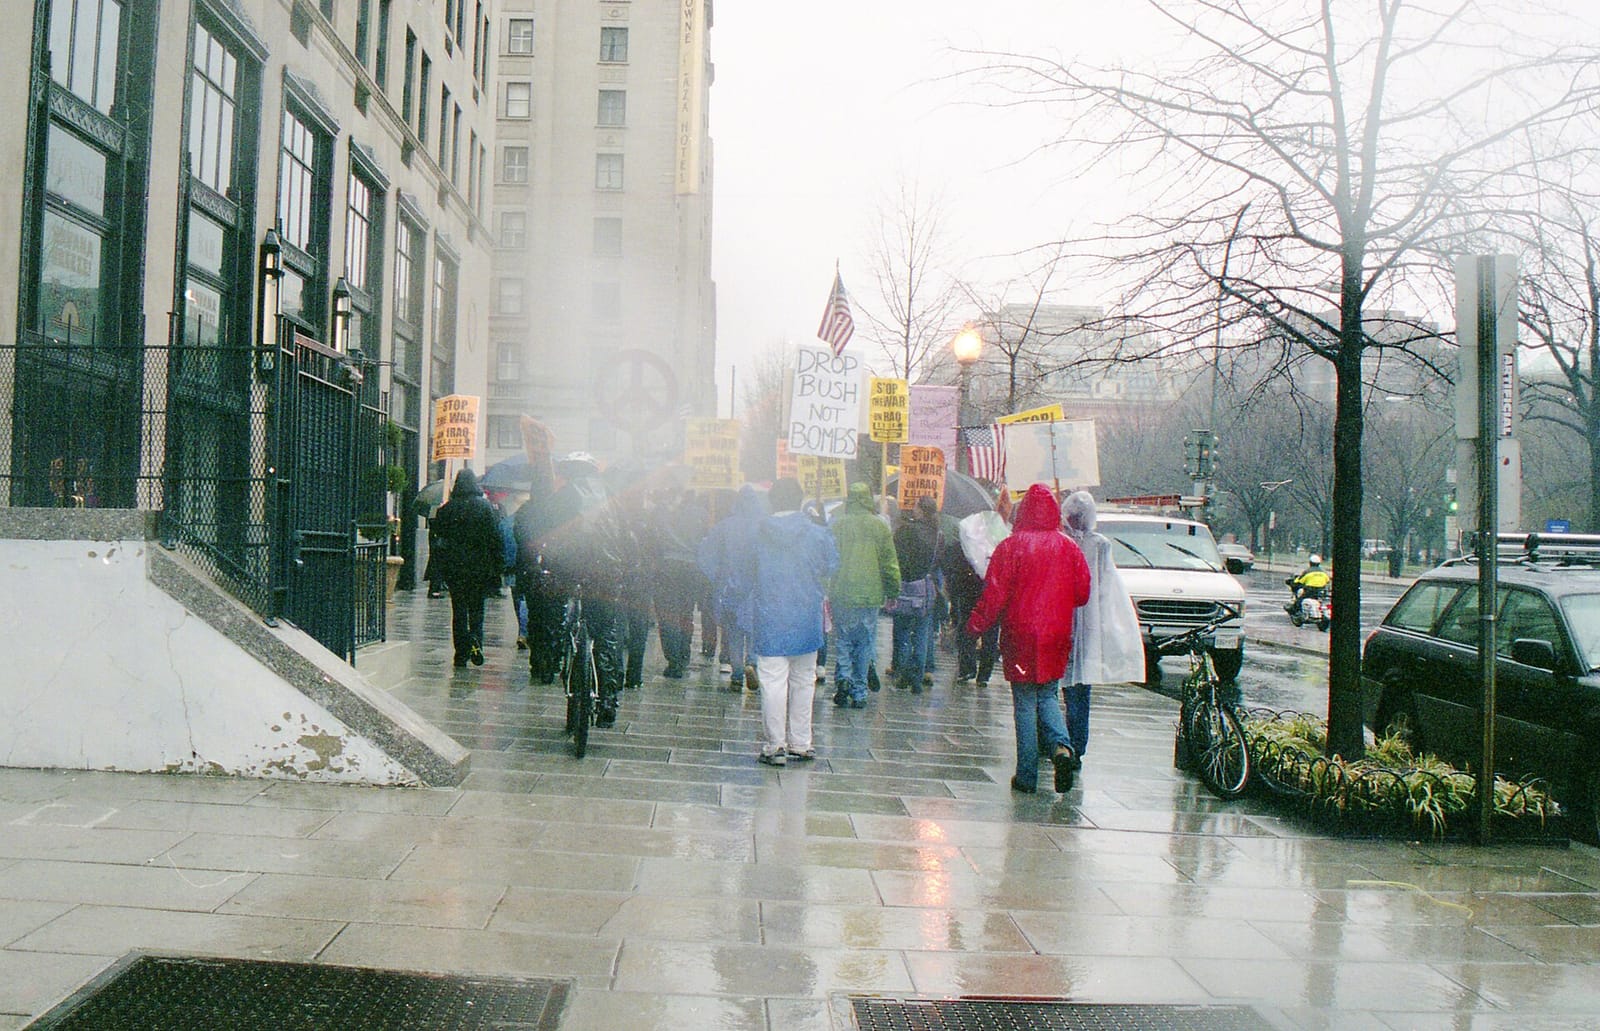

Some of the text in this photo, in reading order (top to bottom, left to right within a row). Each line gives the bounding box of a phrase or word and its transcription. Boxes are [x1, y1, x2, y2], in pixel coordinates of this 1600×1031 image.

[680, 121, 689, 184] HOTEL
[798, 349, 857, 376] DROP
[798, 374, 857, 404] BUSH
[876, 382, 898, 395] STOP
[1502, 353, 1513, 436] ARTIFICIAL
[443, 399, 468, 412] STOP
[884, 396, 906, 408] WAR
[449, 411, 474, 424] WAR
[809, 403, 846, 423] NOT
[446, 427, 469, 438] IRAQ
[791, 421, 857, 456] BOMBS
[912, 449, 937, 461] STOP
[904, 463, 944, 477] THE WAR
[916, 479, 937, 489] IRAQ
